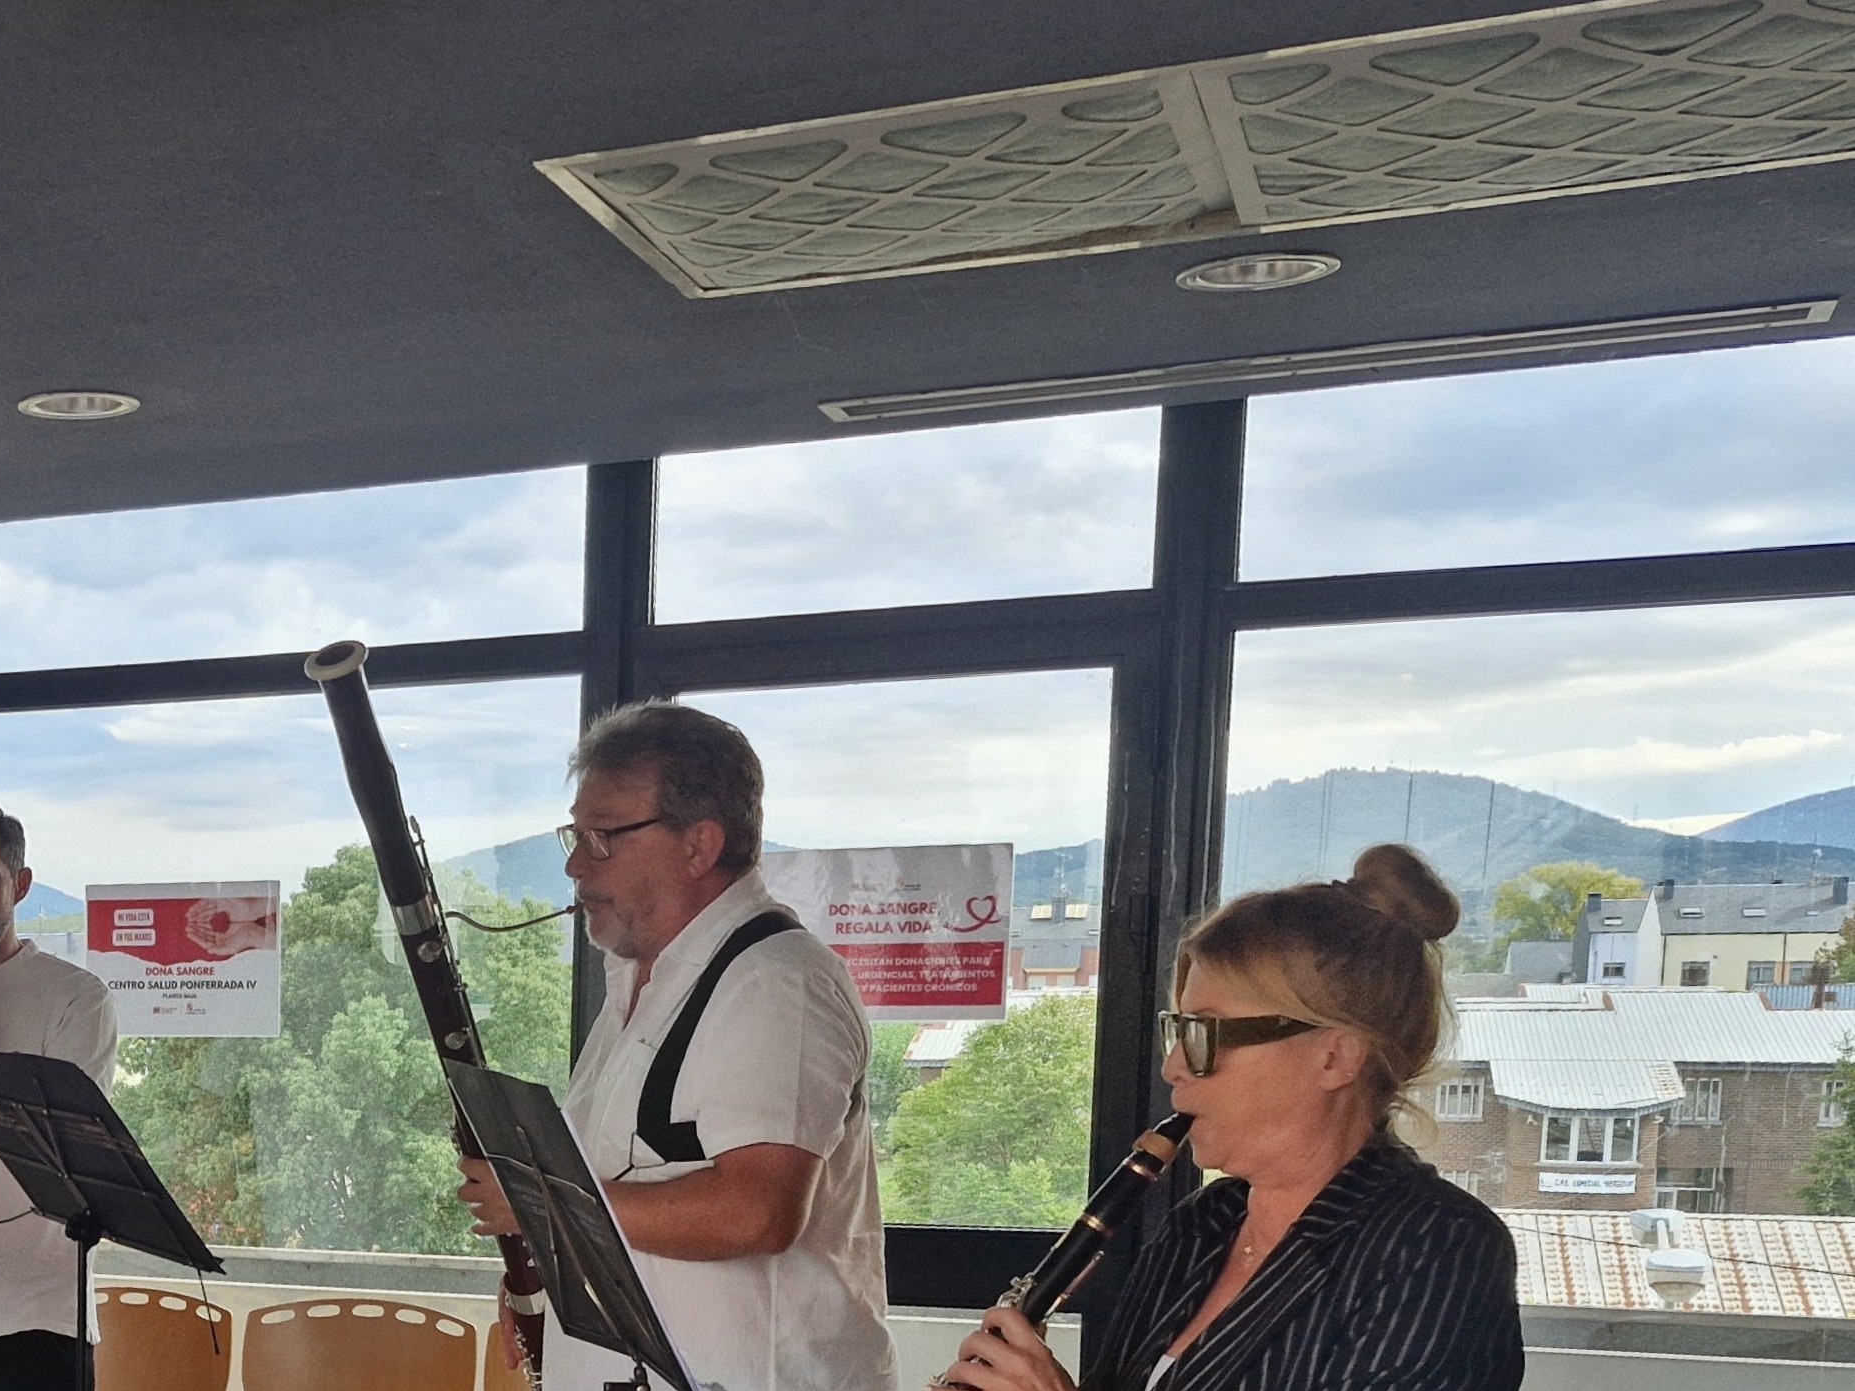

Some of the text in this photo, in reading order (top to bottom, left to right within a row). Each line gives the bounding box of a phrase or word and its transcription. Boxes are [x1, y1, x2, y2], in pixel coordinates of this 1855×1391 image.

[829, 903, 872, 916] DONA
[835, 921, 932, 934] REGALA VIDA
[846, 956, 990, 967] ECESITAN DONACIONES PARA
[145, 966, 215, 976] DONA SANGRE
[919, 969, 996, 980] TRATAMIENTOS
[108, 980, 257, 990] CENTRO SALUD PONFERRADA IV
[862, 984, 869, 992] Y
[869, 983, 923, 992] PACIENTES
